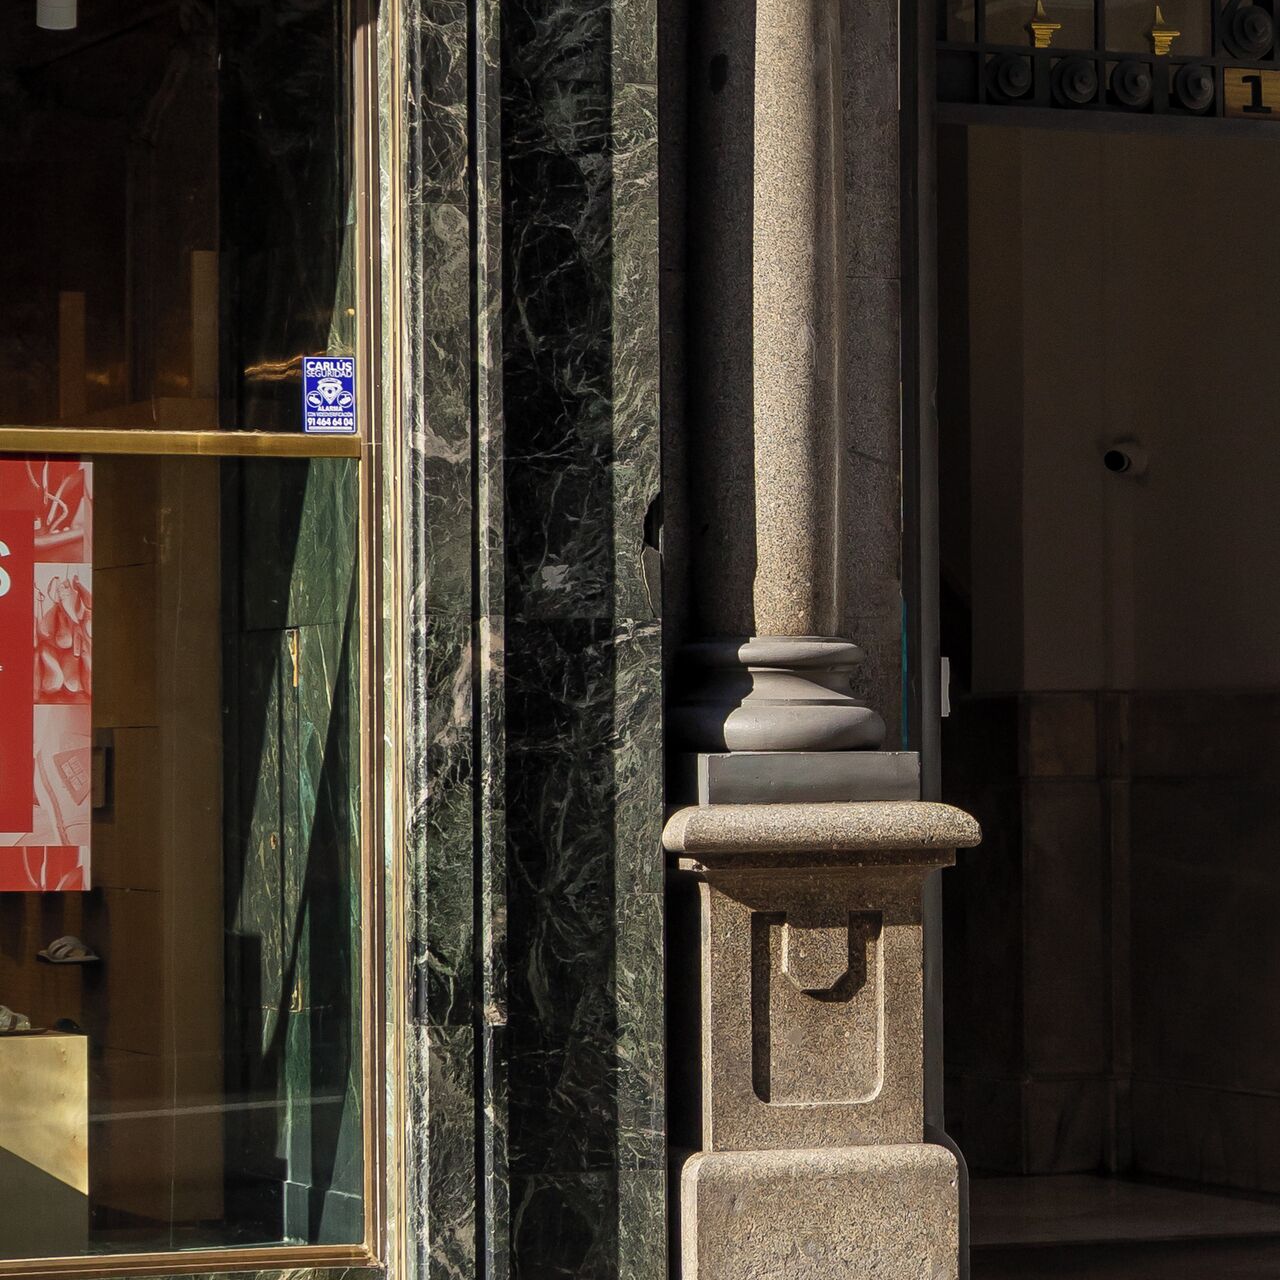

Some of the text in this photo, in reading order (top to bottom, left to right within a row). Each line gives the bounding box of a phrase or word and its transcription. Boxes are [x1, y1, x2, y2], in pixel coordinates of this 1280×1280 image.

[307, 359, 352, 371] CARLÚS
[306, 369, 353, 378] SEGURIDAD
[316, 417, 331, 426] 464
[332, 417, 342, 426] 64
[343, 417, 353, 426] 04
